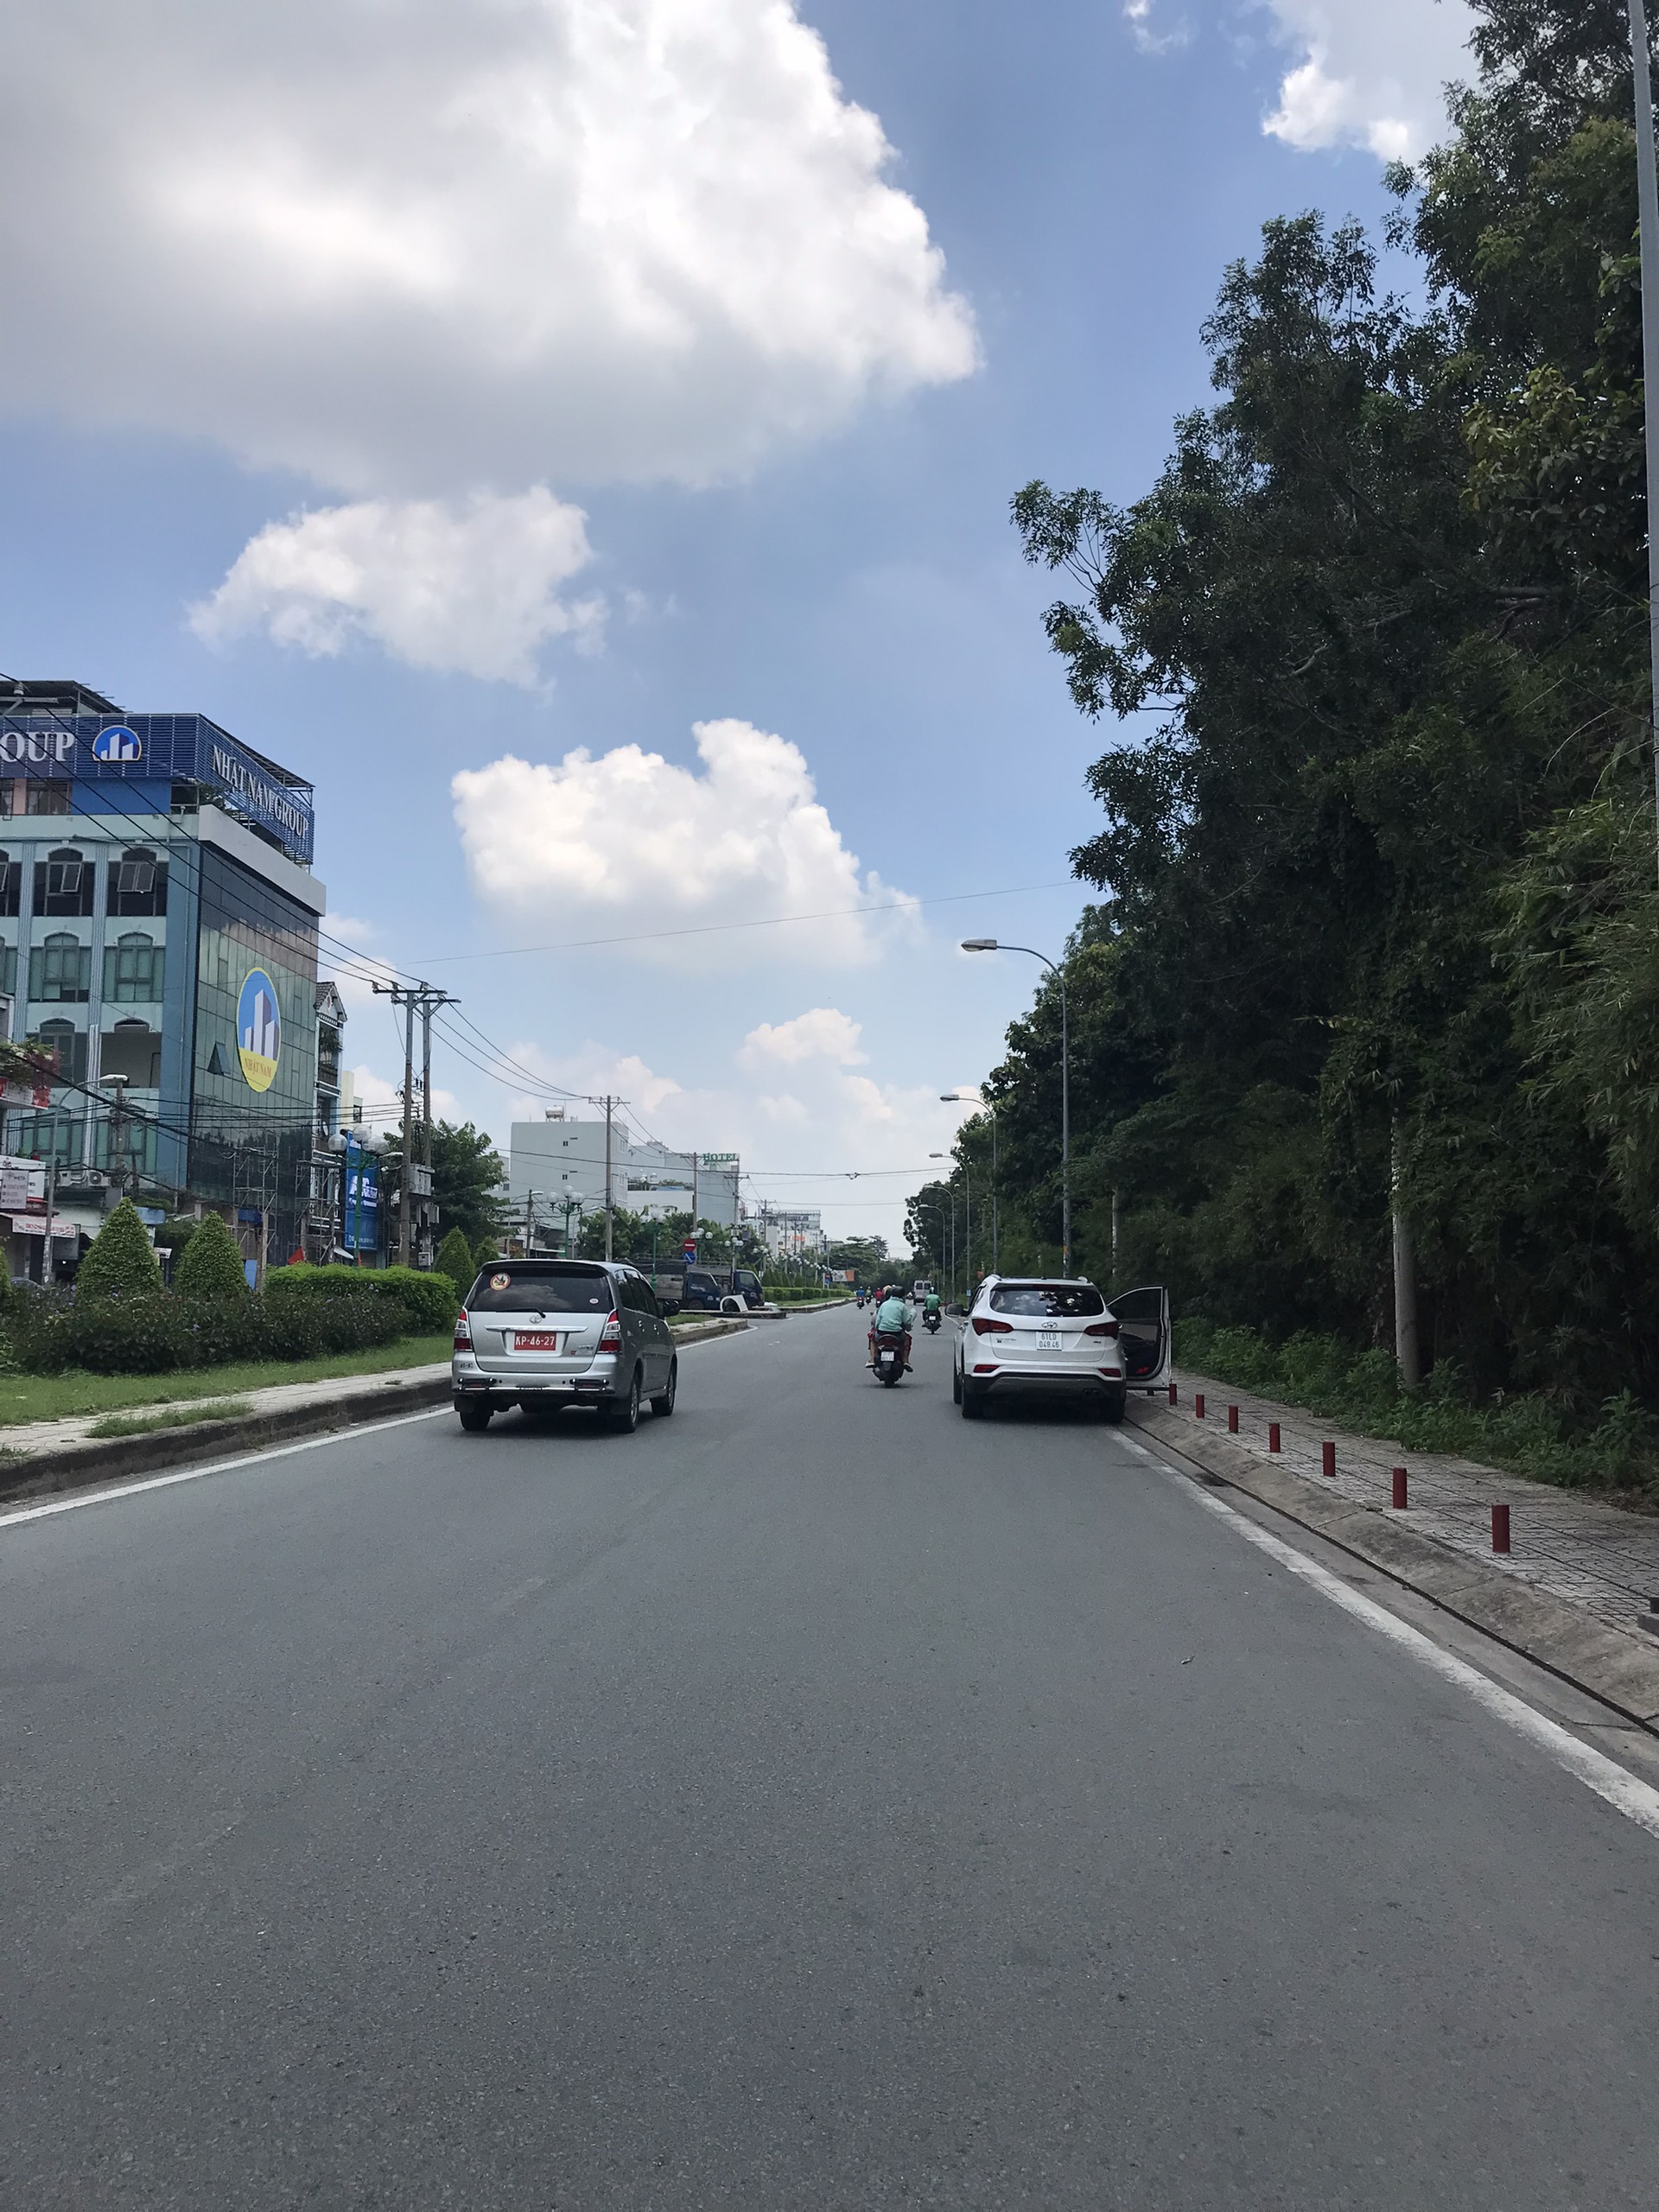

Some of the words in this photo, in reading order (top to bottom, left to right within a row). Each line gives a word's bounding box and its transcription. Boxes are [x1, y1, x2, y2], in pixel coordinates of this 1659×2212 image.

[248, 772, 275, 813] NAM
[274, 795, 308, 840] GROUP
[702, 1153, 740, 1161] HOTEL
[515, 1336, 555, 1346] KP-46-27
